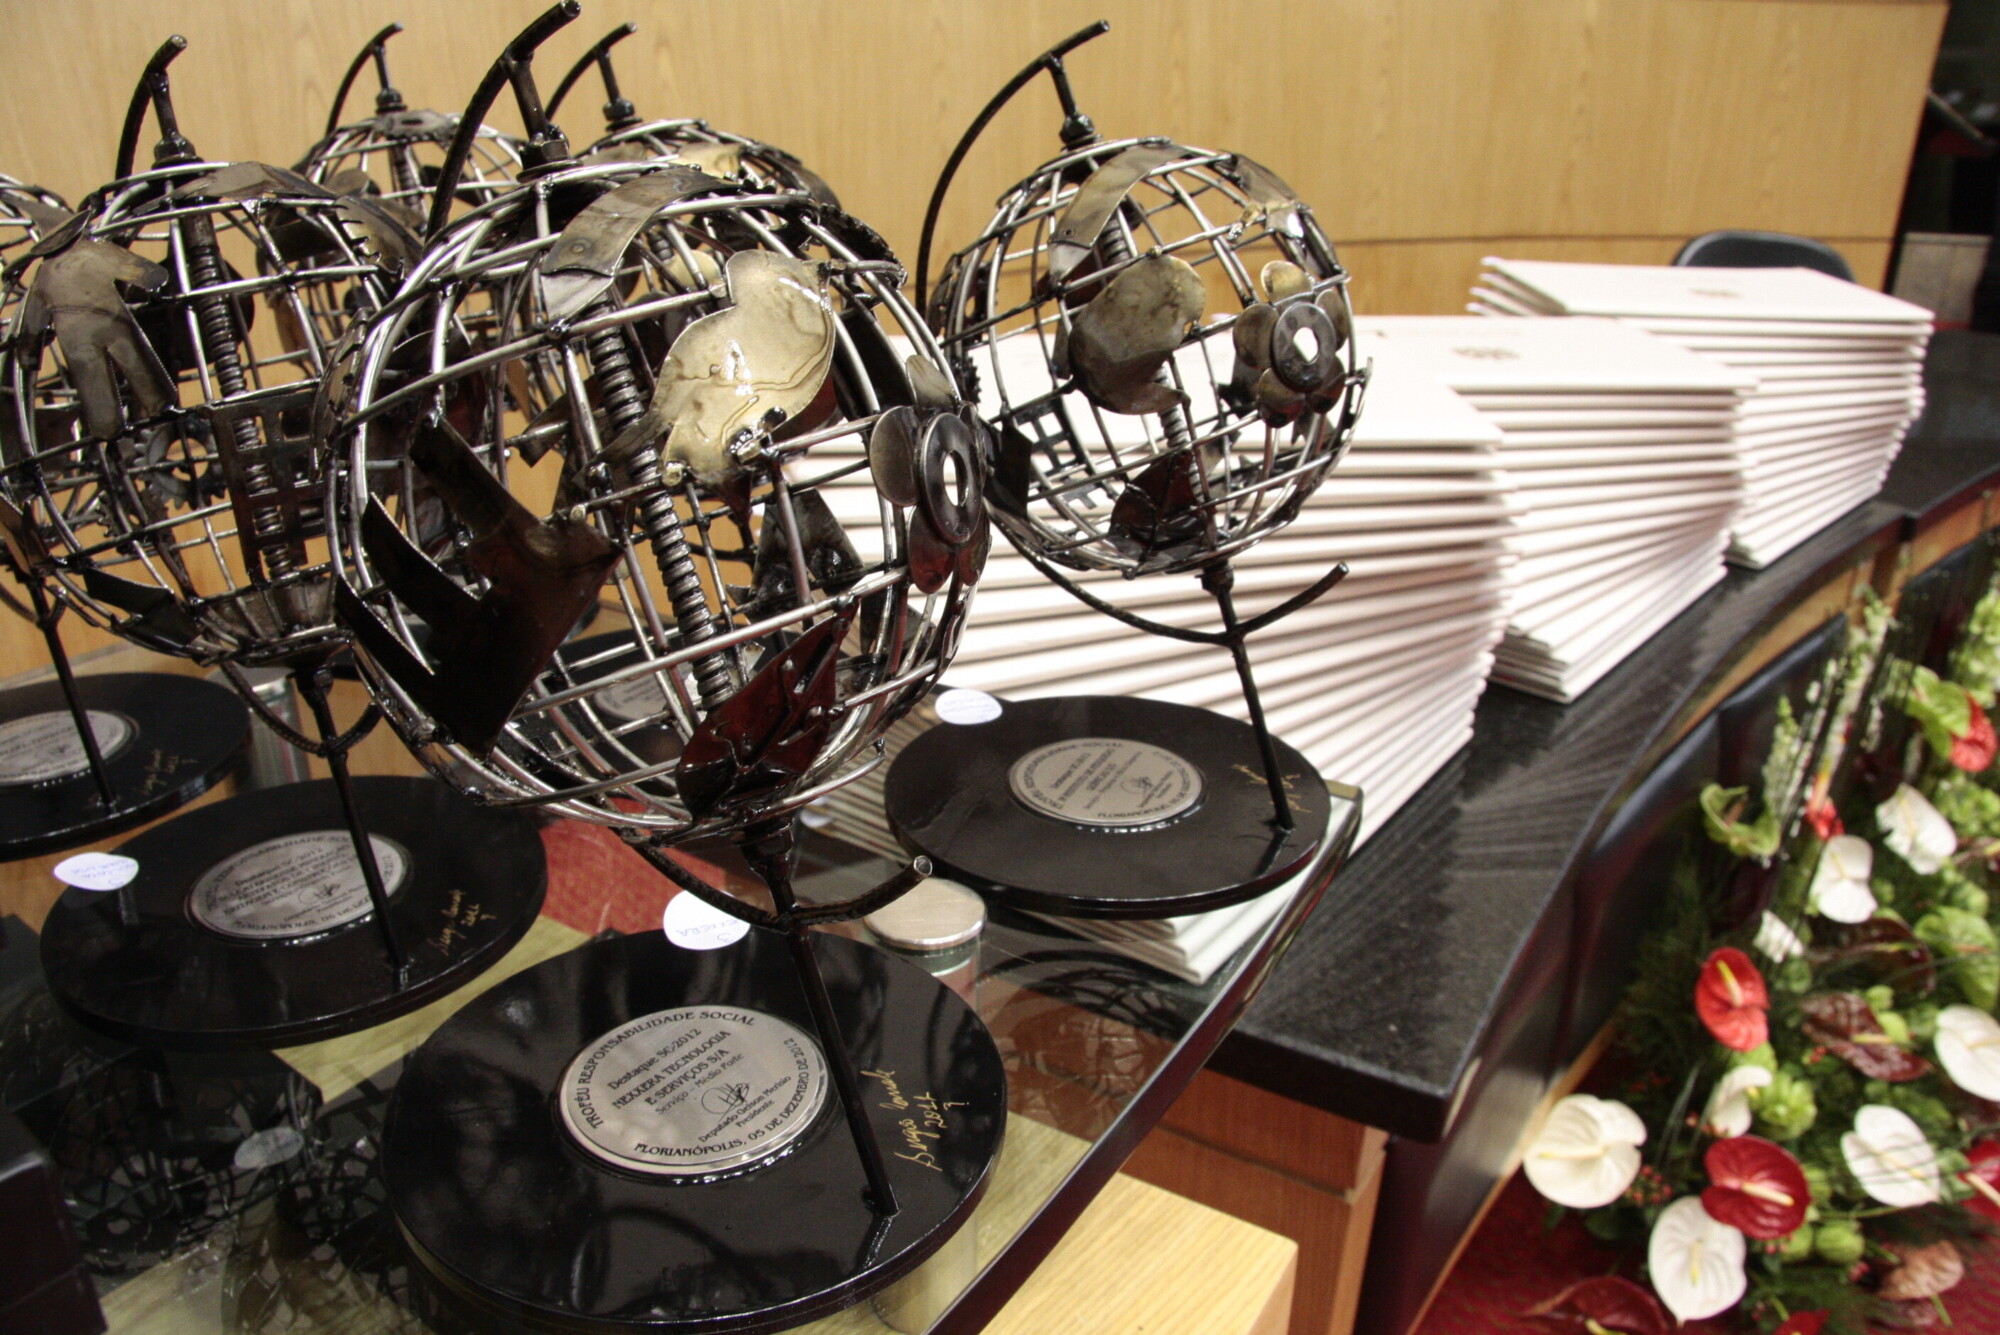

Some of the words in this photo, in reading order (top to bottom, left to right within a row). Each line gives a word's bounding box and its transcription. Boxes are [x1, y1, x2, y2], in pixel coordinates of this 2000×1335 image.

[699, 1011, 756, 1026] SOCIAL
[577, 1011, 696, 1085] RESPONSABILIDADE
[784, 1037, 804, 1058] 2012
[607, 1057, 660, 1090] Destaque
[611, 1074, 667, 1109] NEXXERA
[661, 1030, 732, 1076] TECNOLOGIA
[644, 1096, 658, 1106] E
[654, 1061, 709, 1098] SERVIÇOS
[706, 1048, 730, 1064] S/A
[796, 1058, 808, 1071] DE
[574, 1087, 604, 1129] TROFÉU
[655, 1091, 689, 1115] Serviço
[779, 1071, 809, 1119] DEZEMBRO
[698, 1113, 739, 1143] Deputado
[735, 1099, 776, 1128] Presidente
[764, 1117, 783, 1132] DE
[747, 1128, 766, 1141] 05
